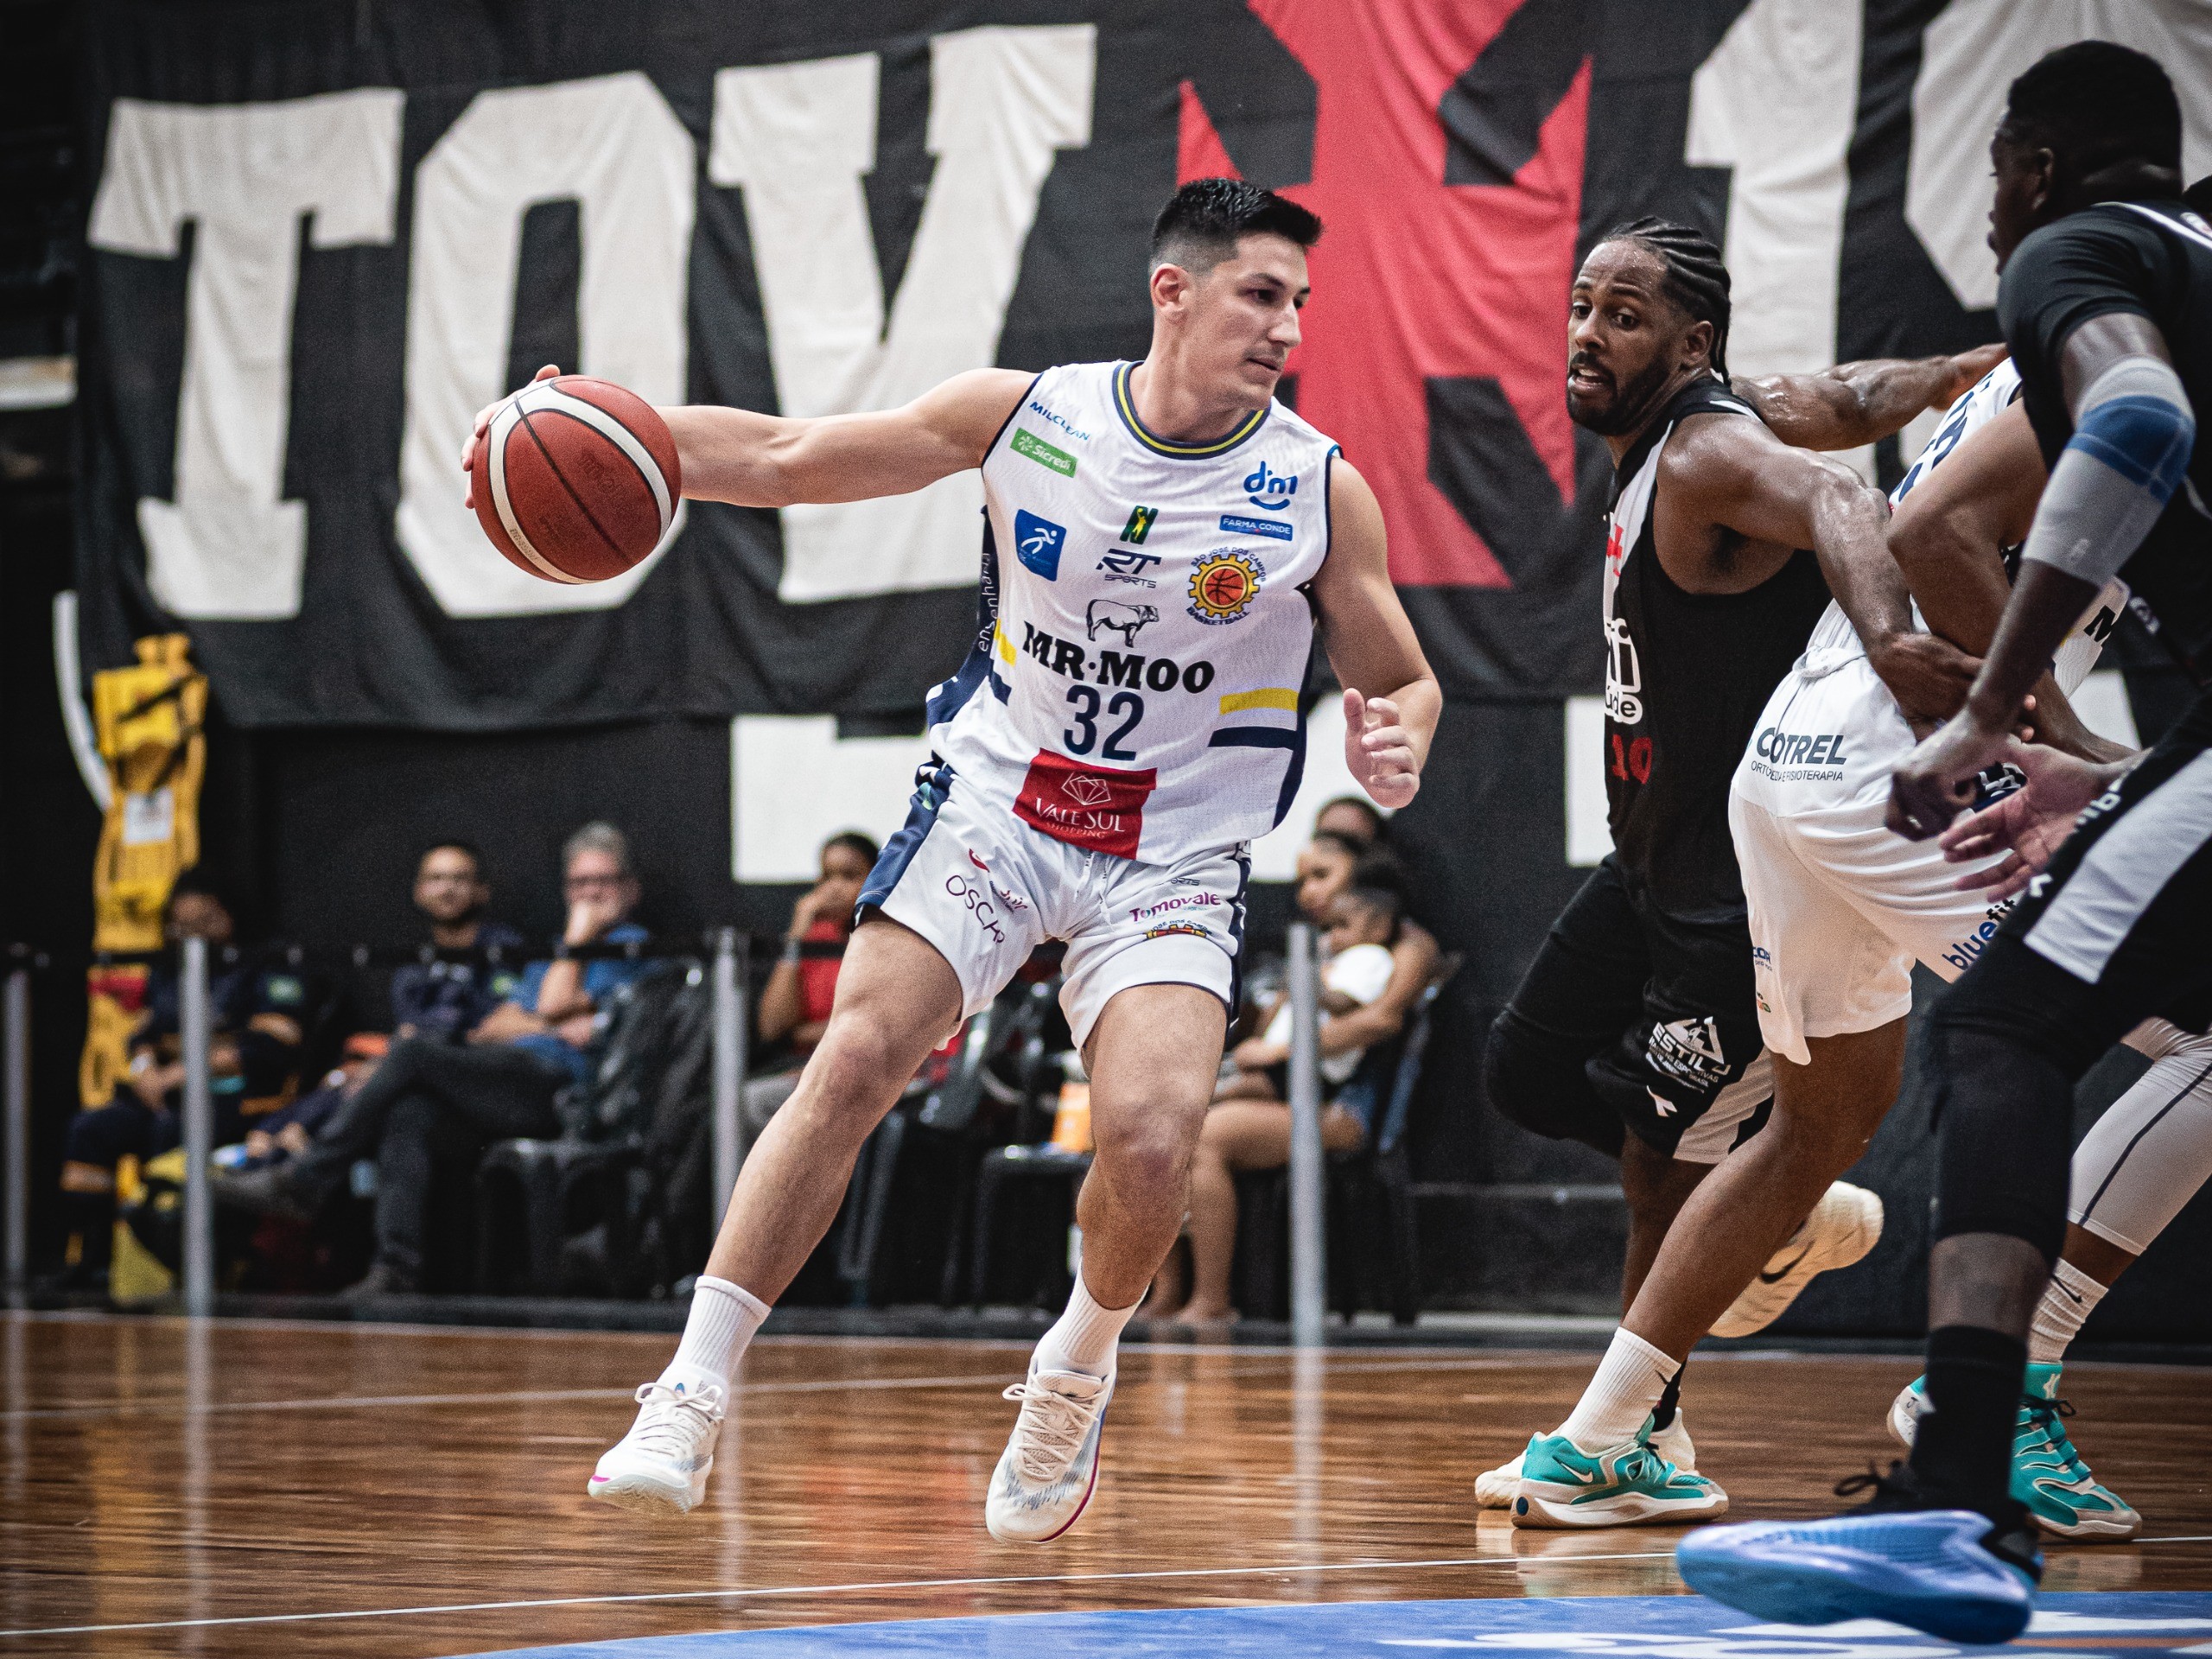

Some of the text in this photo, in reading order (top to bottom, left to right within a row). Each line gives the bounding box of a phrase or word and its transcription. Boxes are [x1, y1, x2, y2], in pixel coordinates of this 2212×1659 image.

[1029, 401, 1090, 441] MILCLEAN
[1032, 444, 1072, 471] Sicredi
[1222, 518, 1292, 535] FARMA CONDE
[1104, 574, 1157, 588] SPORTS
[1063, 683, 1145, 762] 32
[1611, 734, 1653, 784] 10
[1756, 727, 1847, 766] COTREL
[1035, 797, 1126, 833] VALE SUL
[1046, 822, 1109, 839] SHOPPING
[1128, 891, 1221, 922] Tomovale
[1941, 899, 2016, 971] bluefit
